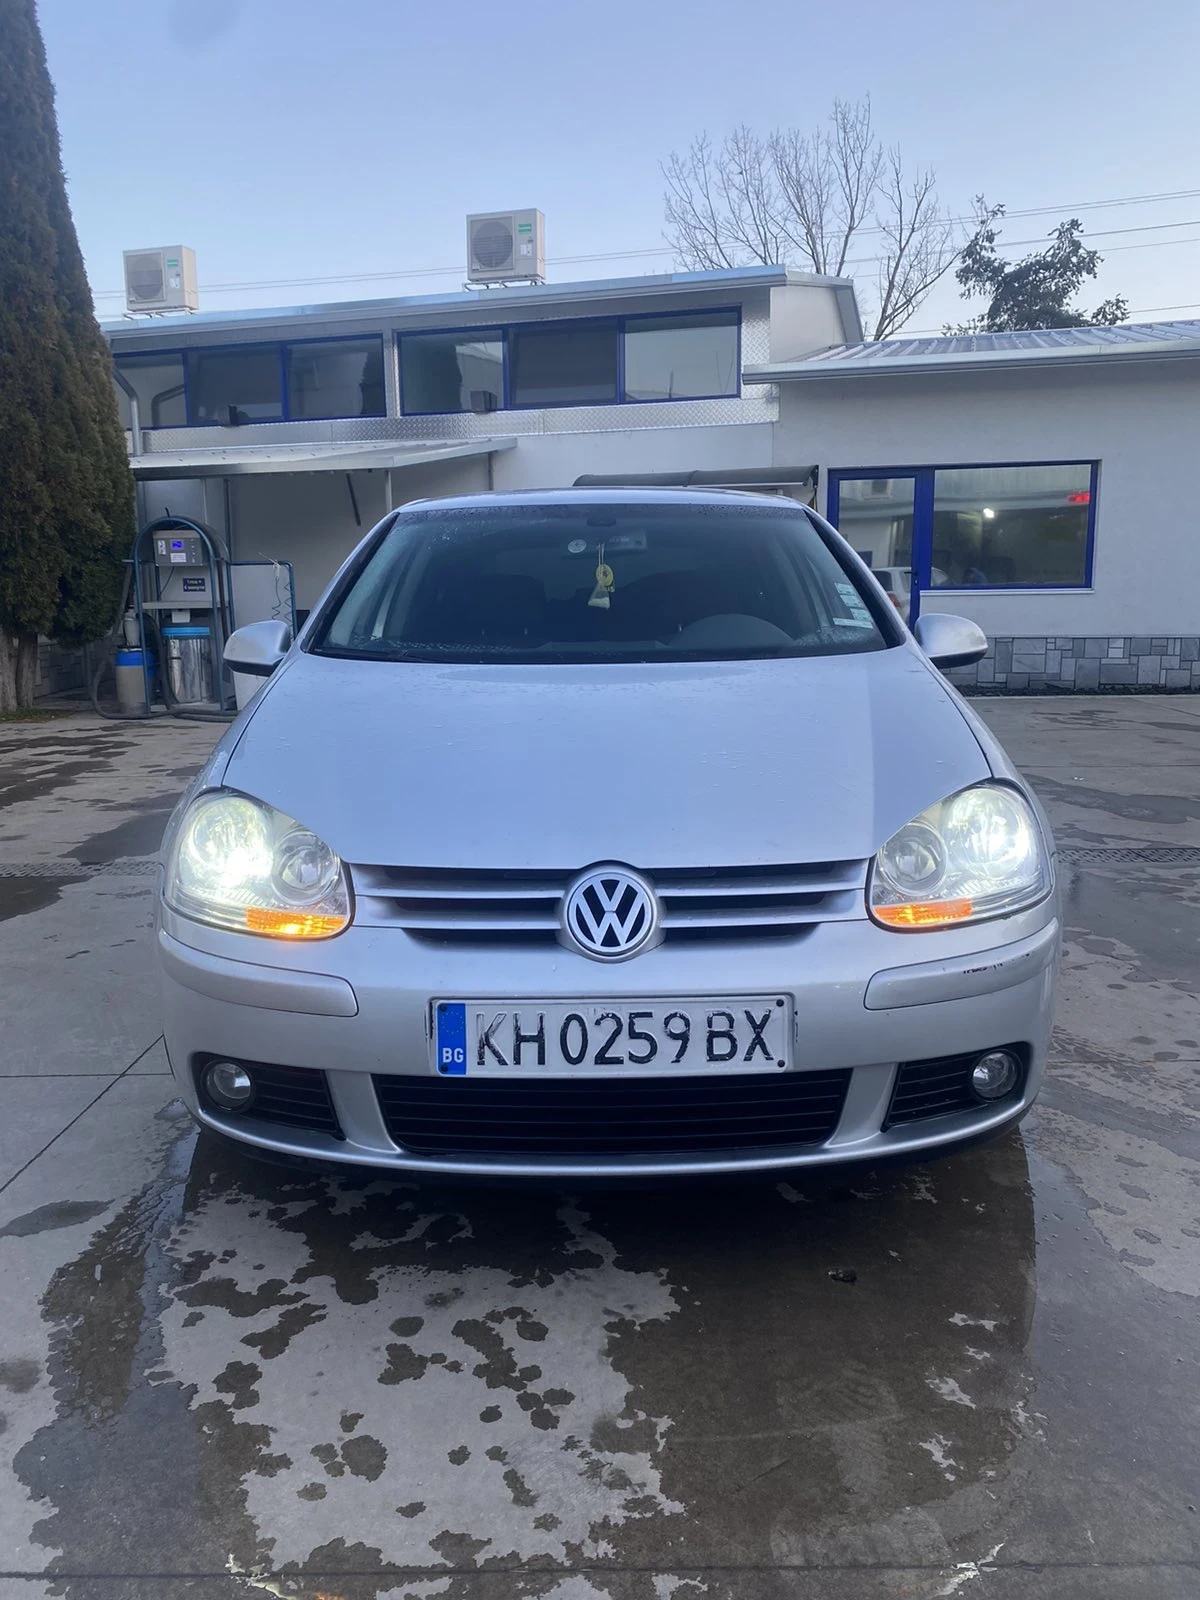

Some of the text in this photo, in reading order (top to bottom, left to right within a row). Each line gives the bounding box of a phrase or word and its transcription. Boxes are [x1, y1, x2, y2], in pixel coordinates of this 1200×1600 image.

[572, 874, 649, 951] VW
[442, 1047, 464, 1063] BG
[476, 1009, 774, 1066] KH 0259 BX
